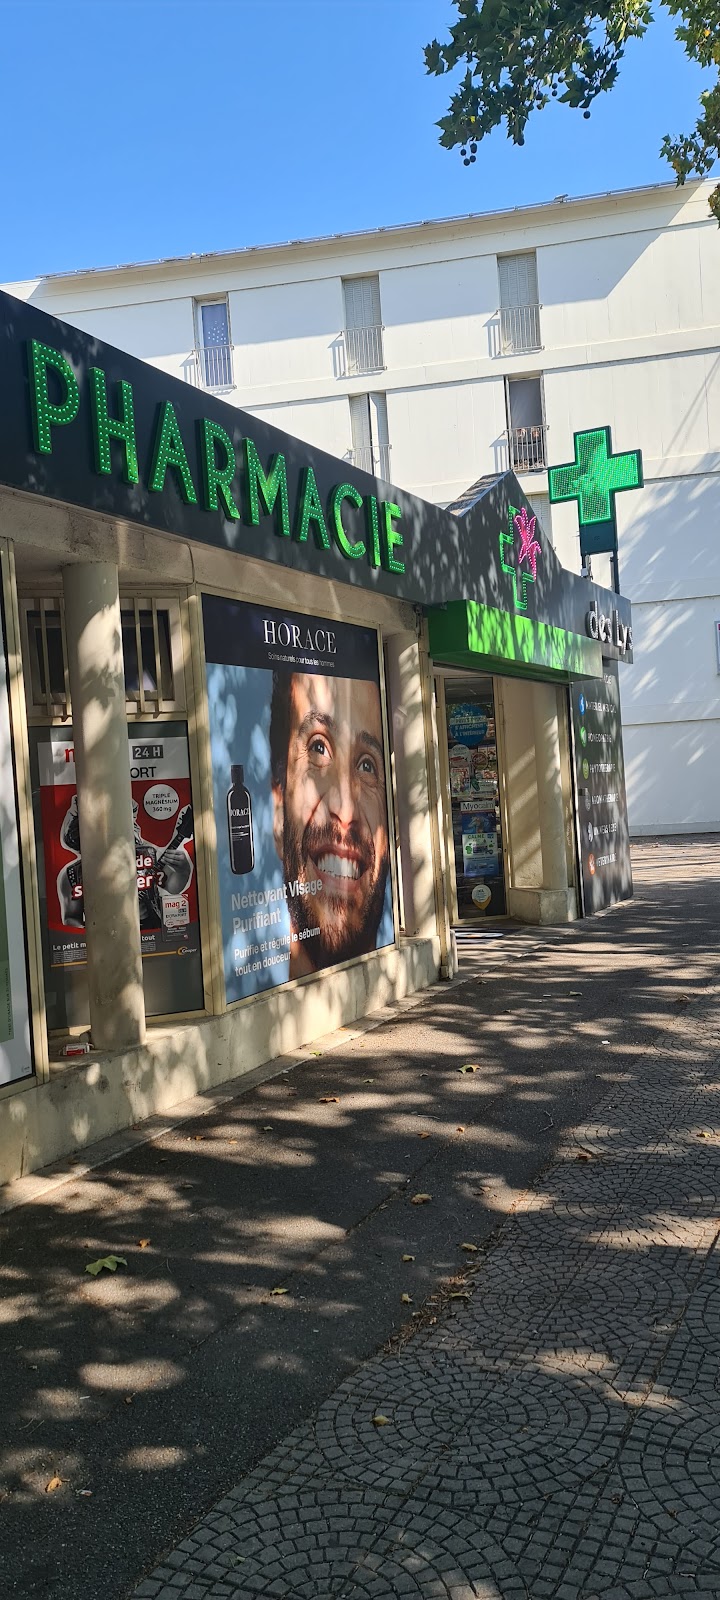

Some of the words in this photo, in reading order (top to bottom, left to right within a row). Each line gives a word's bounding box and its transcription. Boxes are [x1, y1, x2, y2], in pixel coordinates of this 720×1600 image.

[27, 338, 407, 575] PHARMACIE
[262, 619, 337, 654] HORACE
[587, 600, 612, 643] des
[613, 609, 634, 655] Lys
[267, 652, 281, 663] Soins
[280, 654, 296, 664] naturels
[296, 657, 305, 665] pour
[305, 656, 314, 666] tous
[320, 660, 336, 668] hommes
[134, 747, 150, 758] 24
[152, 747, 162, 757] H
[130, 766, 157, 779] ORT
[463, 801, 494, 811] Myocalm
[165, 901, 180, 910] mag
[181, 899, 187, 907] 2
[231, 884, 287, 911] Nettoyant
[287, 877, 323, 898] Visage
[232, 909, 281, 935] Purifiant
[62, 942, 79, 951] petit
[234, 943, 259, 961] Purifie
[260, 942, 268, 952] et
[268, 934, 291, 951] régule
[291, 931, 298, 943] le
[298, 926, 321, 941] sébum
[235, 962, 252, 977] tout
[253, 960, 262, 971] en
[262, 950, 291, 968] douceur
